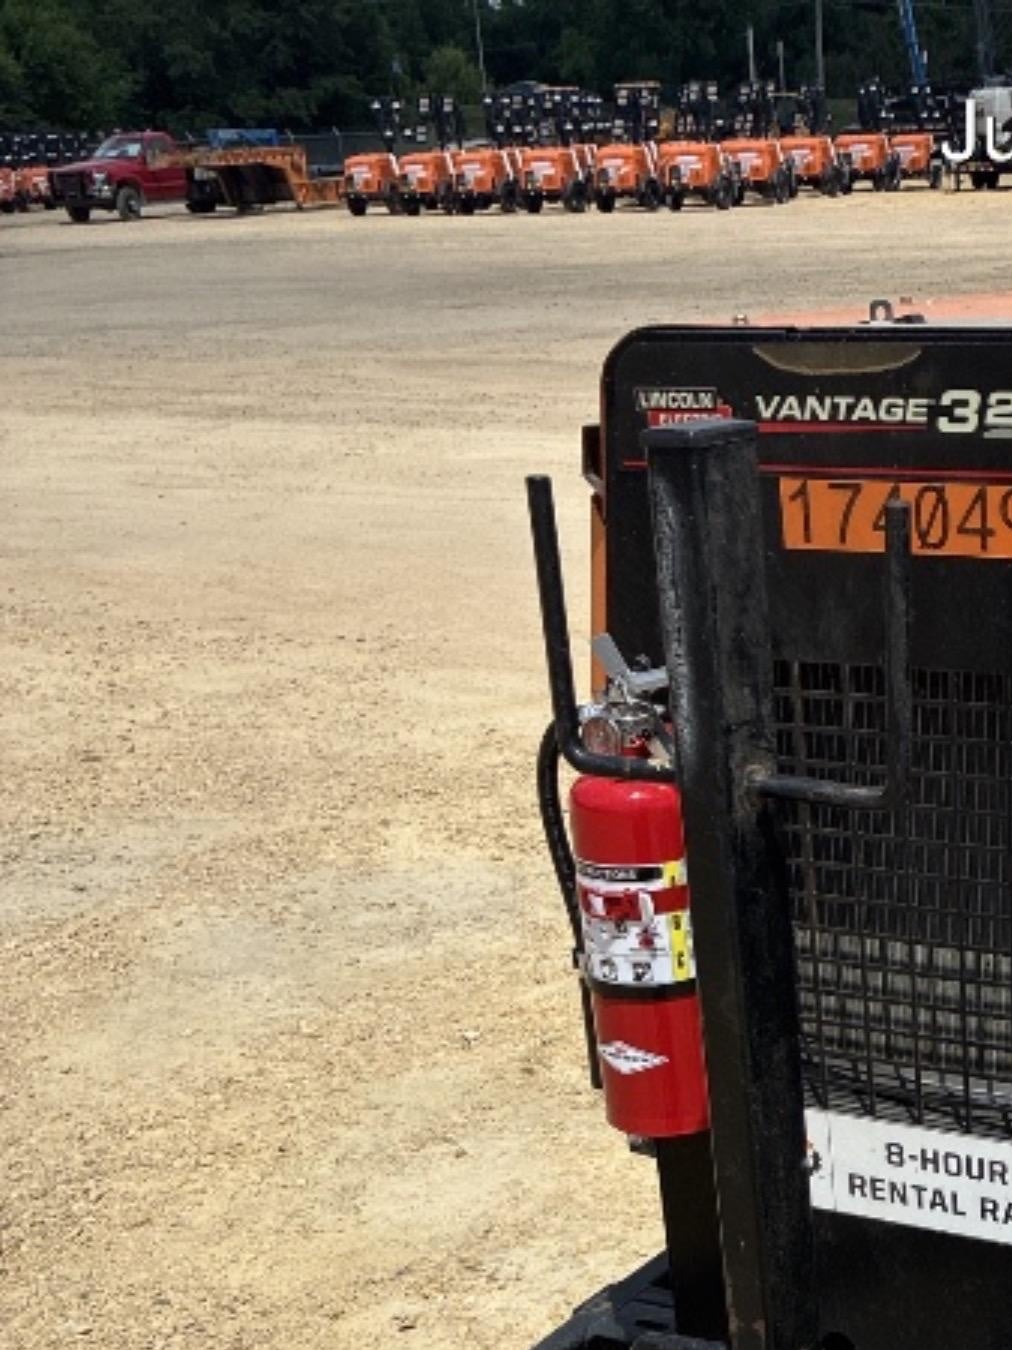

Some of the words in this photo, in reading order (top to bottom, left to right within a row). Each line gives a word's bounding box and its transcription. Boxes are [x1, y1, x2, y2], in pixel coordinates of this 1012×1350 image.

[755, 395, 929, 423] VANTAGE
[884, 1142, 1009, 1186] 8-HOUR
[847, 1172, 967, 1218] RENTAL
